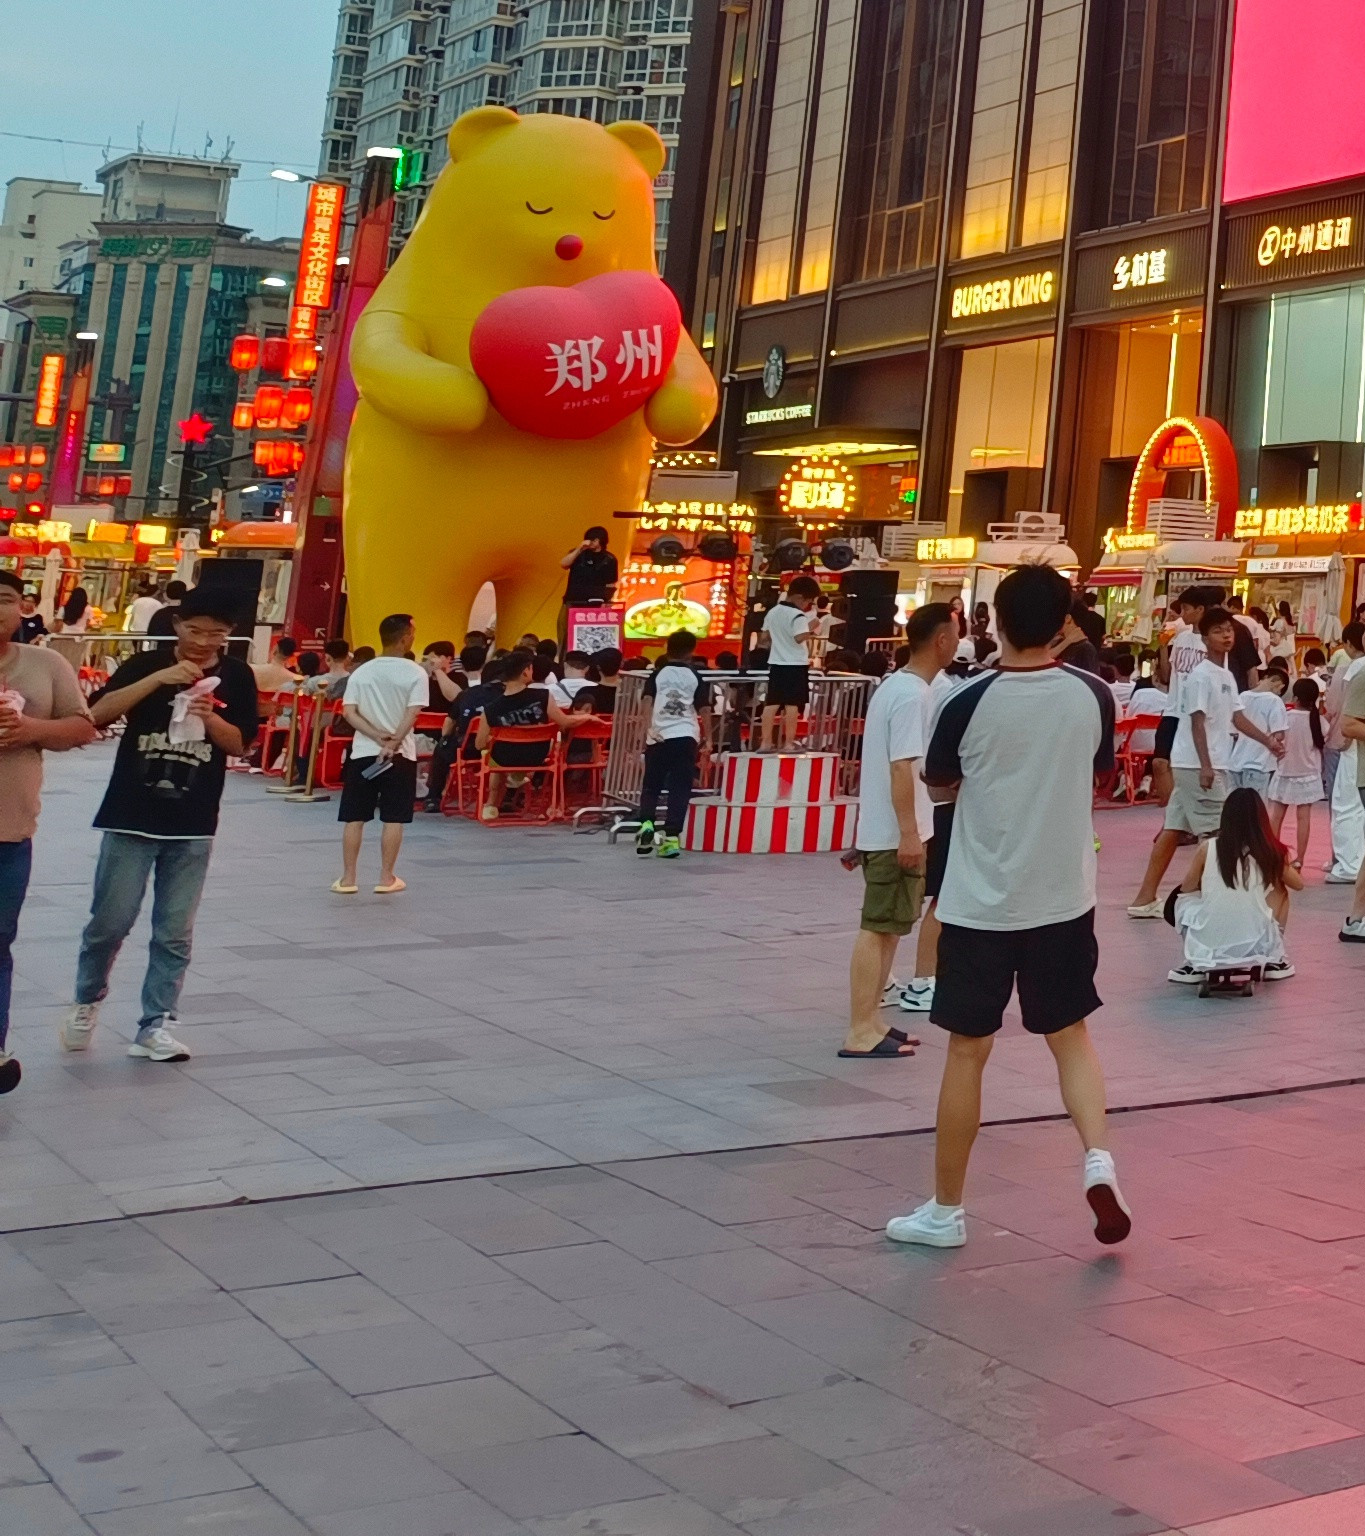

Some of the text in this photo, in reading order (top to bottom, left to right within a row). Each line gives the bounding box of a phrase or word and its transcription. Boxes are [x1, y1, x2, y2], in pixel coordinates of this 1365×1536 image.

[1280, 216, 1352, 259] 中州通讯
[1112, 248, 1168, 292] 乡村基
[951, 271, 1054, 318] BURGER KING
[544, 324, 662, 397] 郑州
[789, 480, 846, 509] 剧场
